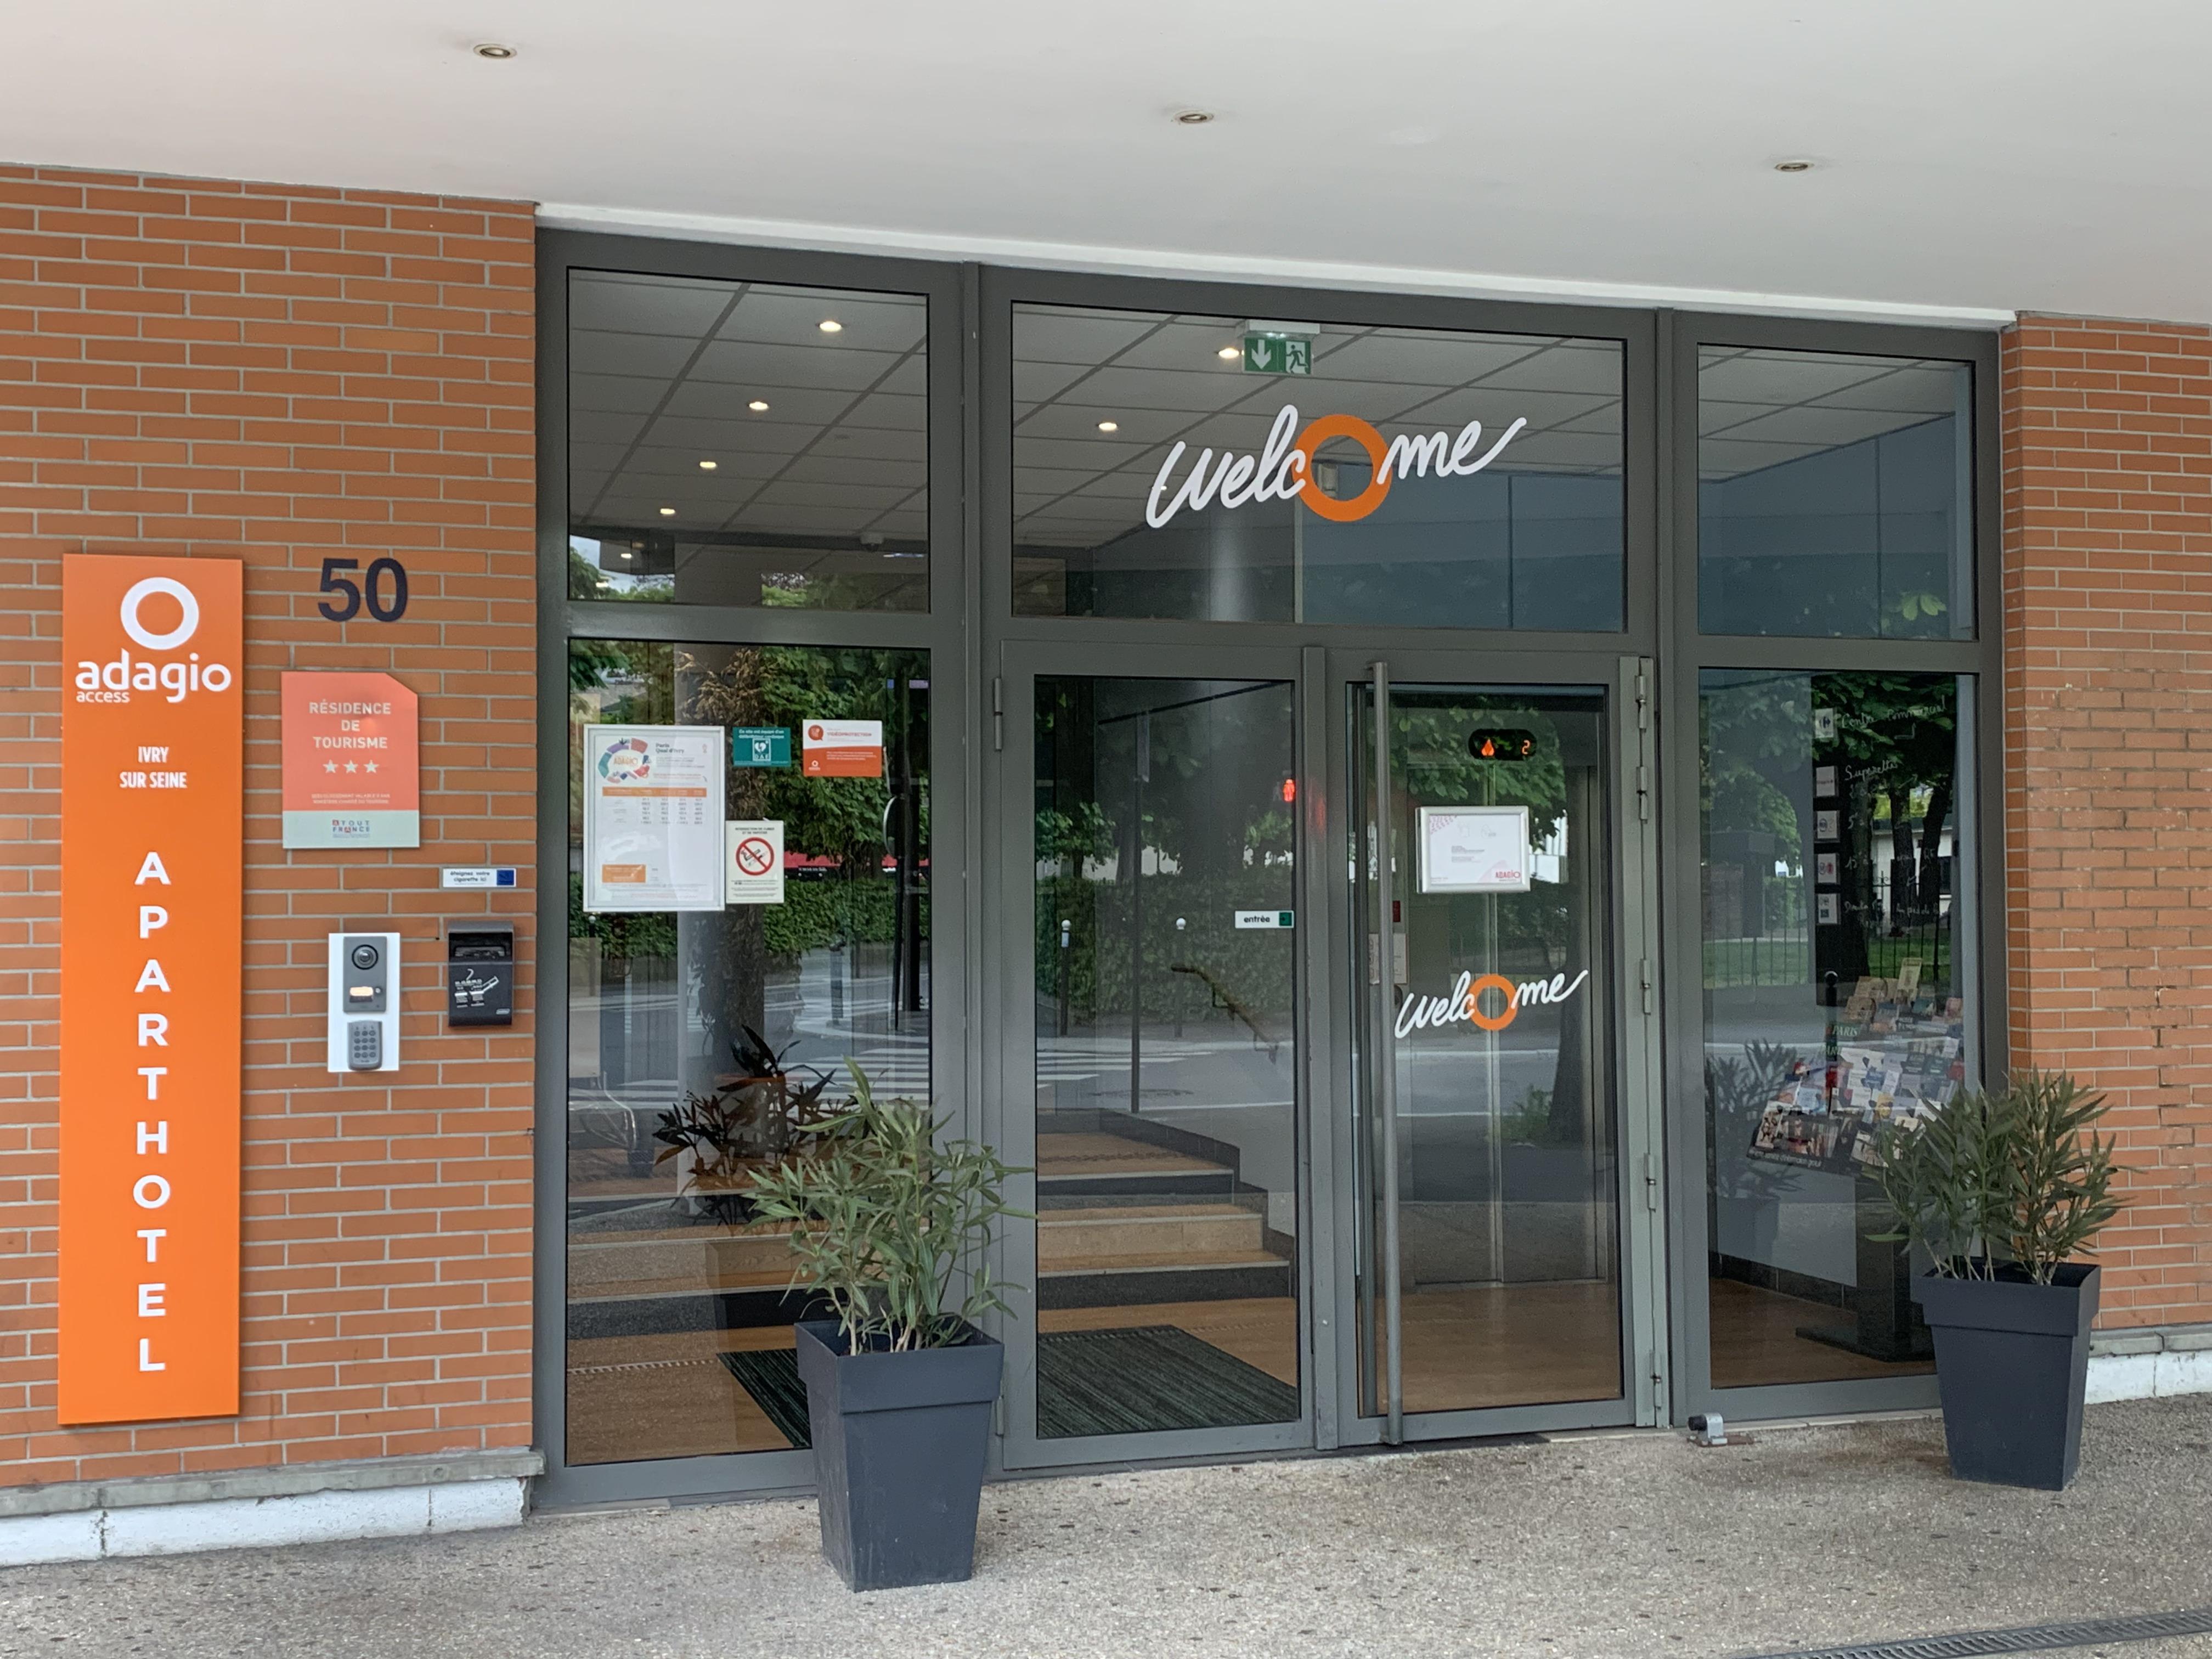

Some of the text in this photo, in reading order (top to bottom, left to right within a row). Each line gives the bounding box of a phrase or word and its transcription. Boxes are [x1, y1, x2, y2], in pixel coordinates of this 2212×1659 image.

[318, 557, 408, 622] 50
[75, 648, 231, 703] adagio
[76, 691, 130, 703] access
[309, 699, 392, 714] RÉSIDENCE
[341, 720, 360, 731] DE
[313, 737, 387, 749] TOURISME
[1521, 740, 1531, 754] 2
[138, 746, 169, 763] IVRY
[120, 771, 187, 788] SUR SEINE
[1832, 1025, 1858, 1036] PARIS
[133, 851, 171, 1372] APARTHOTEL
